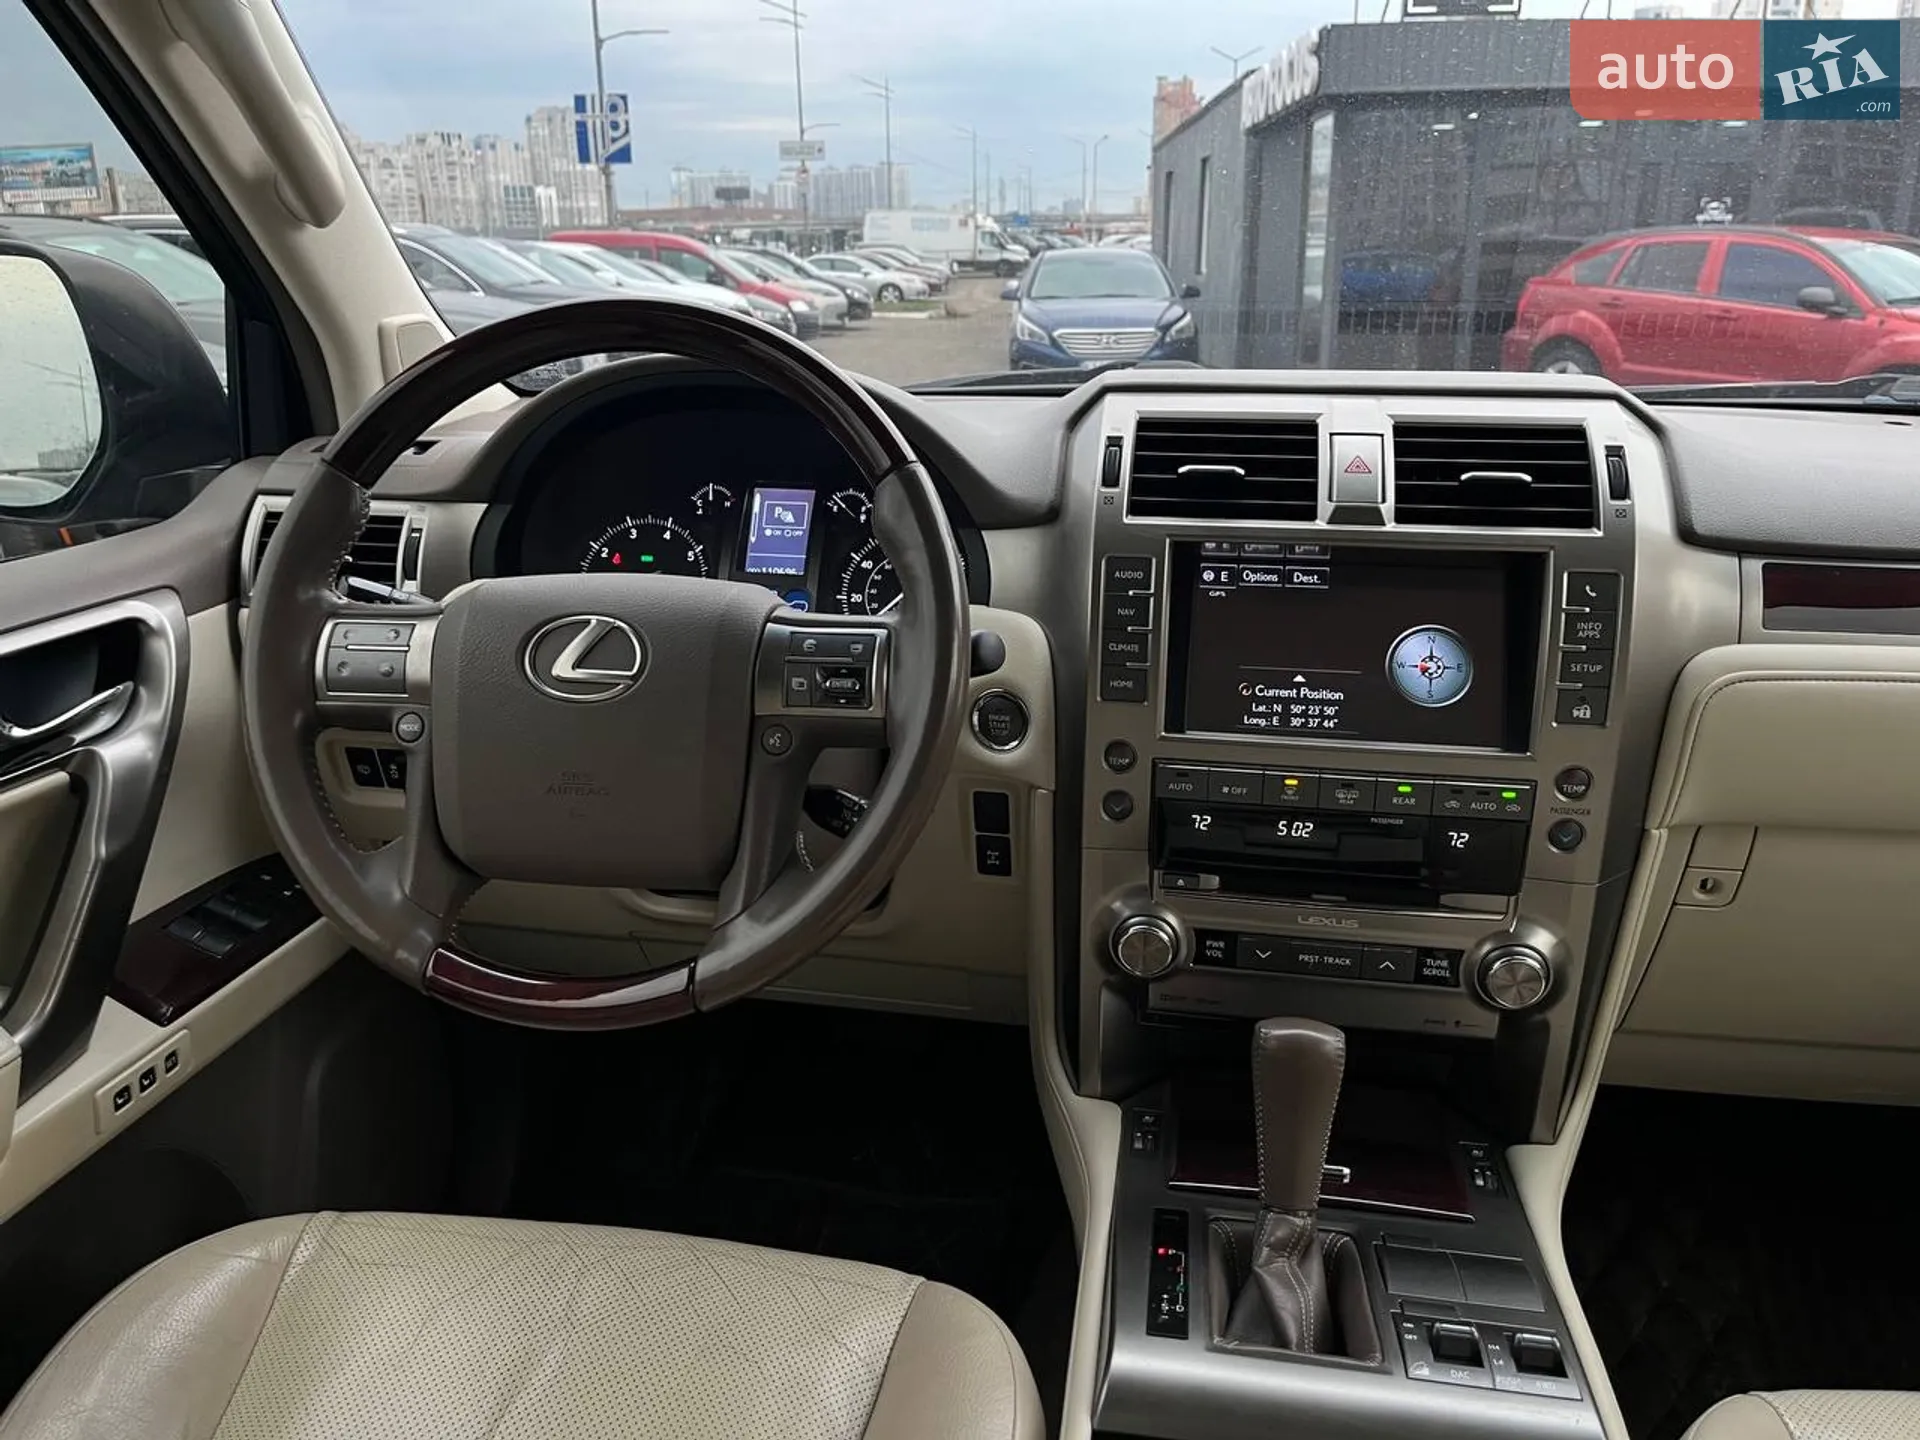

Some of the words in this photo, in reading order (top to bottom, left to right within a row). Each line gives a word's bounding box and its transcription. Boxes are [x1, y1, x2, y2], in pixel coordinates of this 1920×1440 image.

[630, 528, 638, 539] 3
[663, 530, 670, 540] 4
[601, 548, 608, 558] 2
[687, 550, 695, 562] 5
[860, 560, 873, 570] 40
[1114, 570, 1144, 579] AUDIO
[1243, 570, 1278, 583] Options
[1293, 572, 1321, 584] Dest.
[850, 593, 862, 603] 20
[1118, 608, 1136, 616] NAV
[1576, 622, 1602, 630] INFO
[1576, 630, 1601, 638] APPS
[1428, 636, 1436, 644] N
[1108, 642, 1139, 652] CLIMATE
[1570, 664, 1603, 672] SETUP
[1110, 680, 1134, 688] HOME
[1255, 684, 1297, 698] Current
[1300, 687, 1344, 700] Position
[1273, 704, 1282, 712] N
[1272, 716, 1280, 726] E
[1168, 782, 1193, 792] AUTO
[1231, 786, 1248, 795] OFF
[1562, 784, 1586, 793] TEMP
[1392, 796, 1416, 806] REAR
[1470, 802, 1497, 811] AUTO
[1550, 806, 1591, 816] PASSENGER
[1191, 814, 1212, 831] 72
[1448, 832, 1470, 848] 72
[1297, 915, 1359, 929] LEXUS
[1206, 940, 1225, 949] PWR
[1426, 958, 1449, 968] TUNE
[1422, 967, 1451, 978] SCROLL
